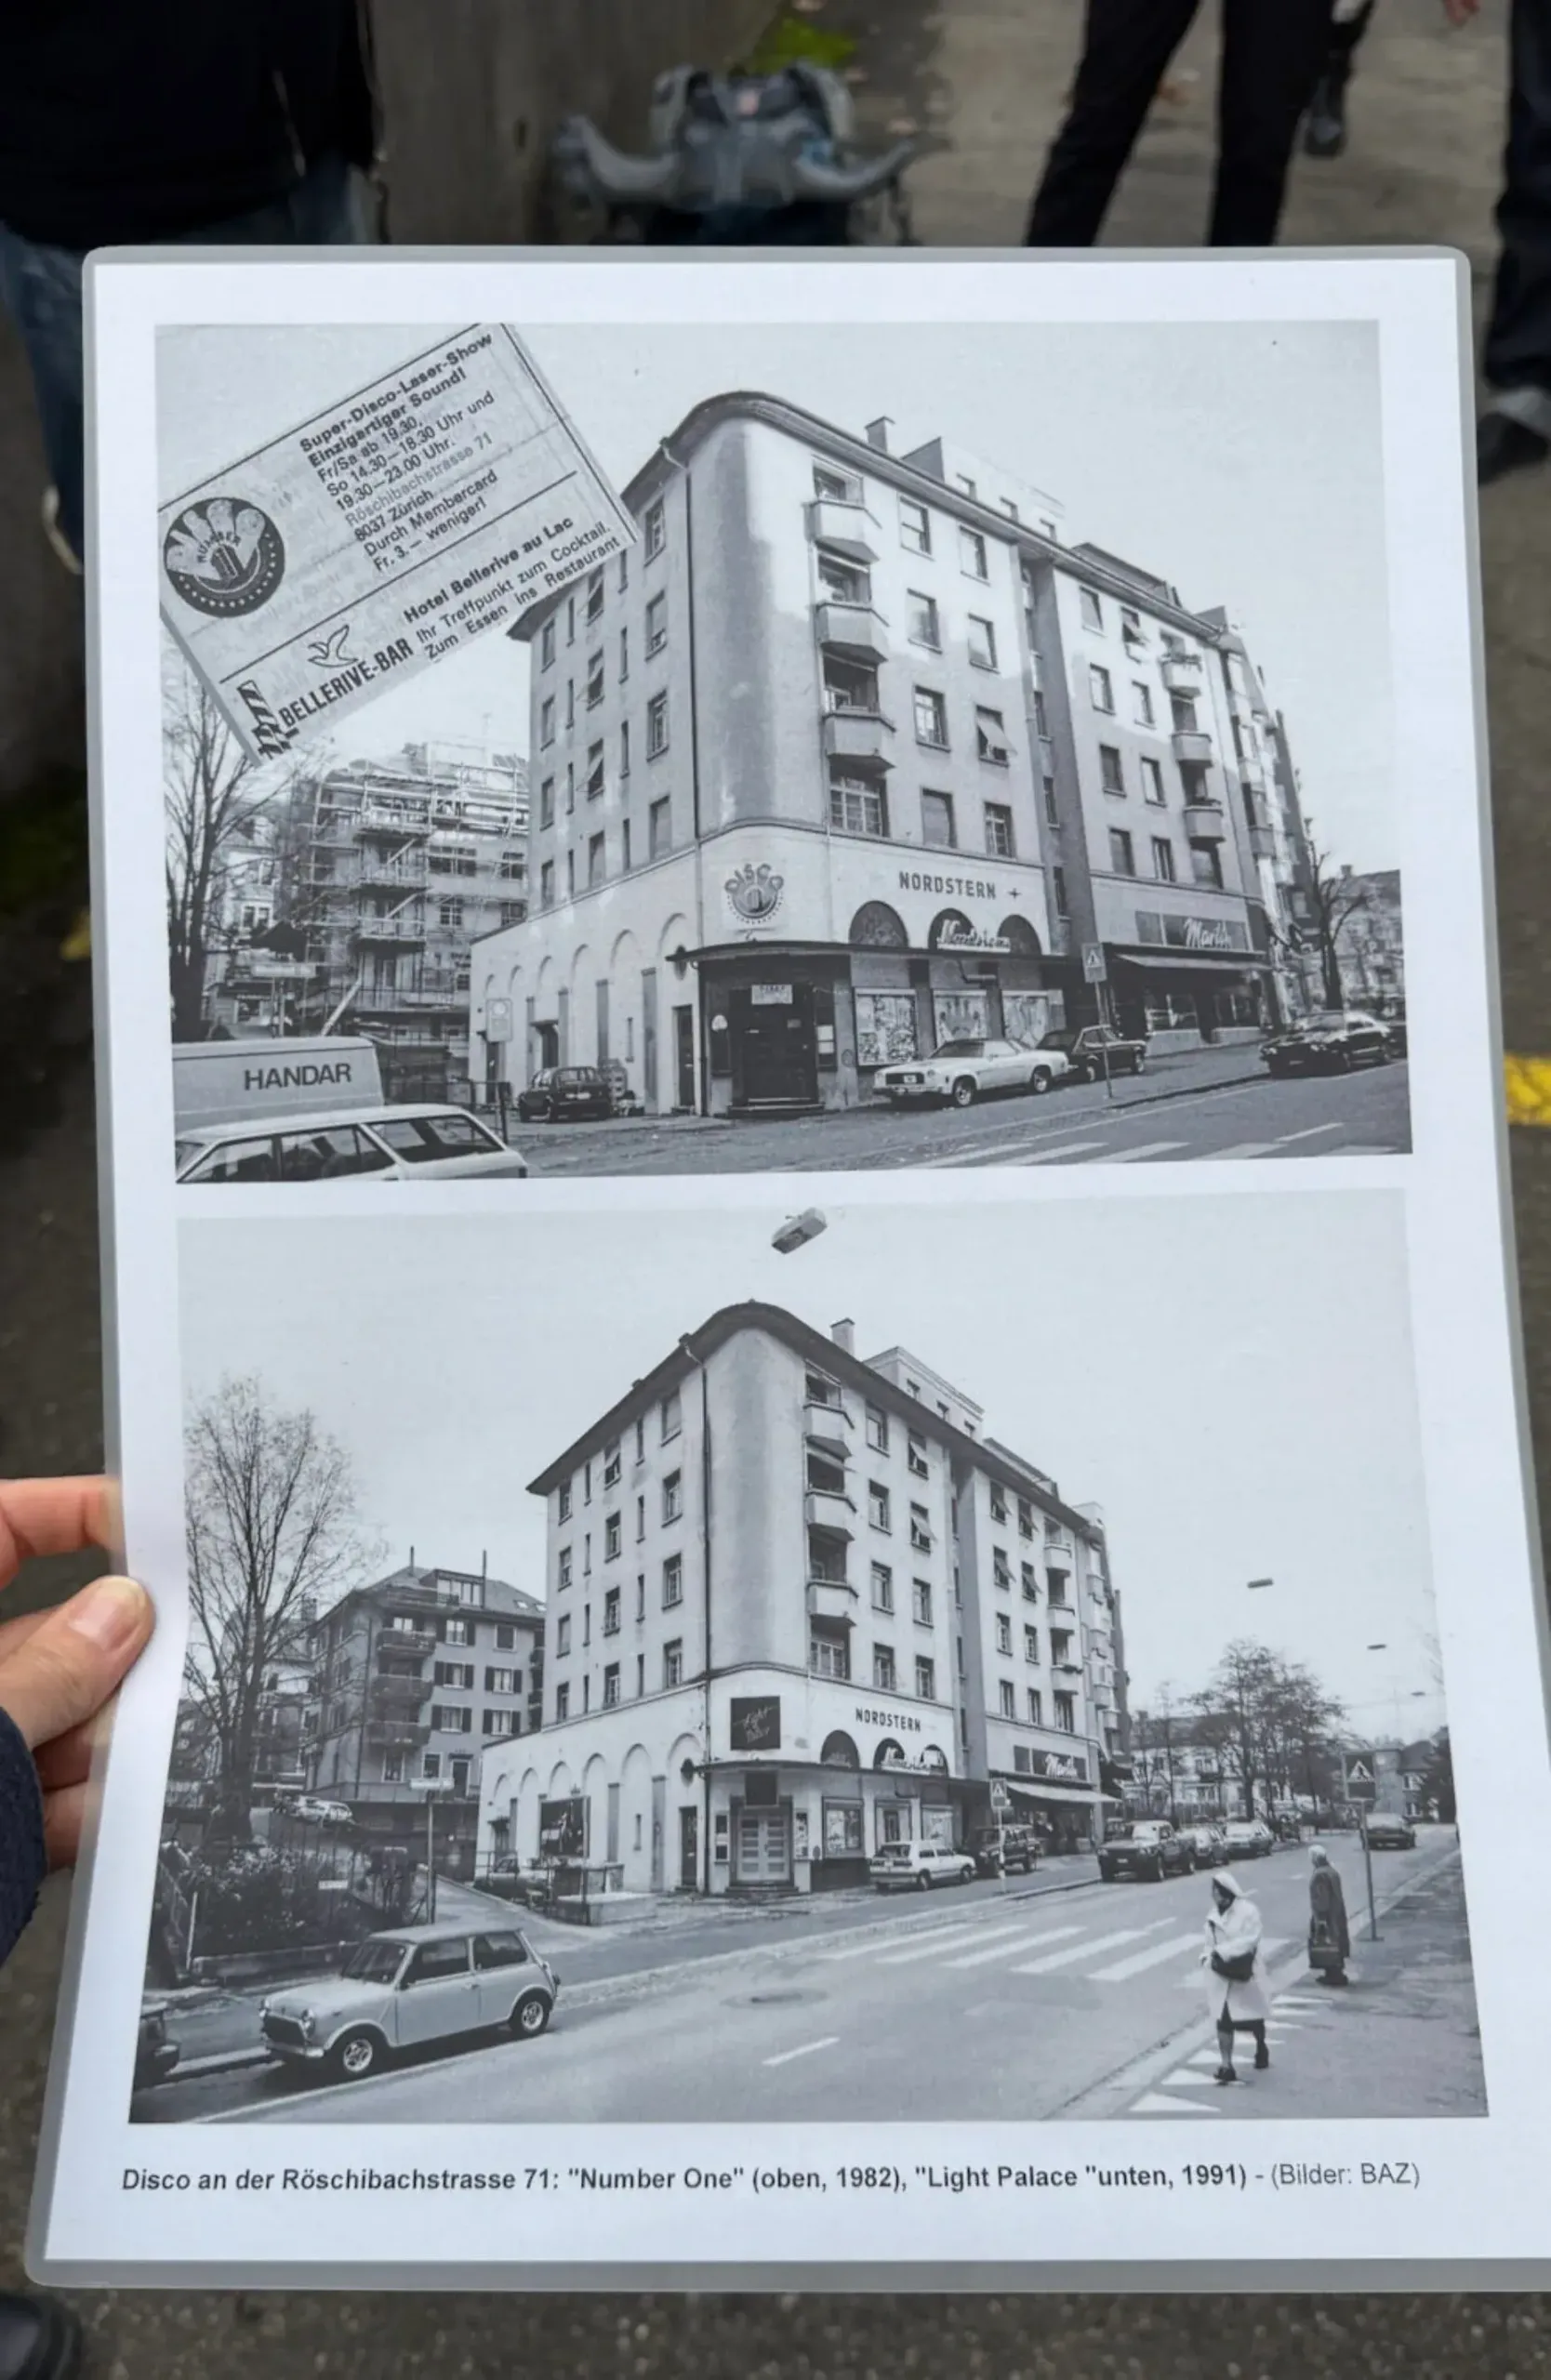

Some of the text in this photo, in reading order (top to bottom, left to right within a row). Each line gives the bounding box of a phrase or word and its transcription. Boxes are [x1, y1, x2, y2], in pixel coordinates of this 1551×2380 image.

[299, 334, 492, 453] Super-Disco-Laser-Show
[307, 366, 467, 469] Einzigartiger Sound!
[316, 454, 360, 483] Fr/Sa
[360, 439, 383, 458] ab
[326, 480, 349, 496] So
[435, 410, 463, 431] Uhr
[467, 390, 495, 415] und
[472, 431, 493, 450] 71
[353, 489, 436, 543] 8037 Zürich
[364, 469, 498, 558] Durch Membercard
[372, 556, 395, 573] Fr.
[425, 496, 487, 541] weniger!
[403, 518, 574, 624] Hotel Bellerive au Lac
[416, 521, 611, 643] Ihr Treffpunkt zum Cocktail.
[424, 536, 620, 660] Zum Essen ins Restaurant
[278, 638, 414, 728] BELLERIVE-BAR
[898, 870, 997, 901] NORDSTERN
[244, 1063, 352, 1091] HANDAR
[855, 1707, 921, 1734] NORDSTERN
[122, 2169, 191, 2190] Disco
[198, 2174, 227, 2190] an
[235, 2169, 275, 2190] der
[283, 2168, 516, 2190] Röschibachstrasse
[524, 2168, 559, 2189] 71:
[568, 2168, 676, 2189] "Number
[683, 2167, 744, 2188] One"
[752, 2167, 827, 2194] (oben,
[837, 2166, 907, 2194] 1982),
[915, 2166, 990, 2194] "Light
[998, 2165, 1078, 2188] Palace
[1085, 2165, 1173, 2190] "unten,
[1182, 2163, 1246, 2190] 1991)
[1271, 2163, 1351, 2190] (Bilder:
[1361, 2162, 1420, 2188] BAZ)
